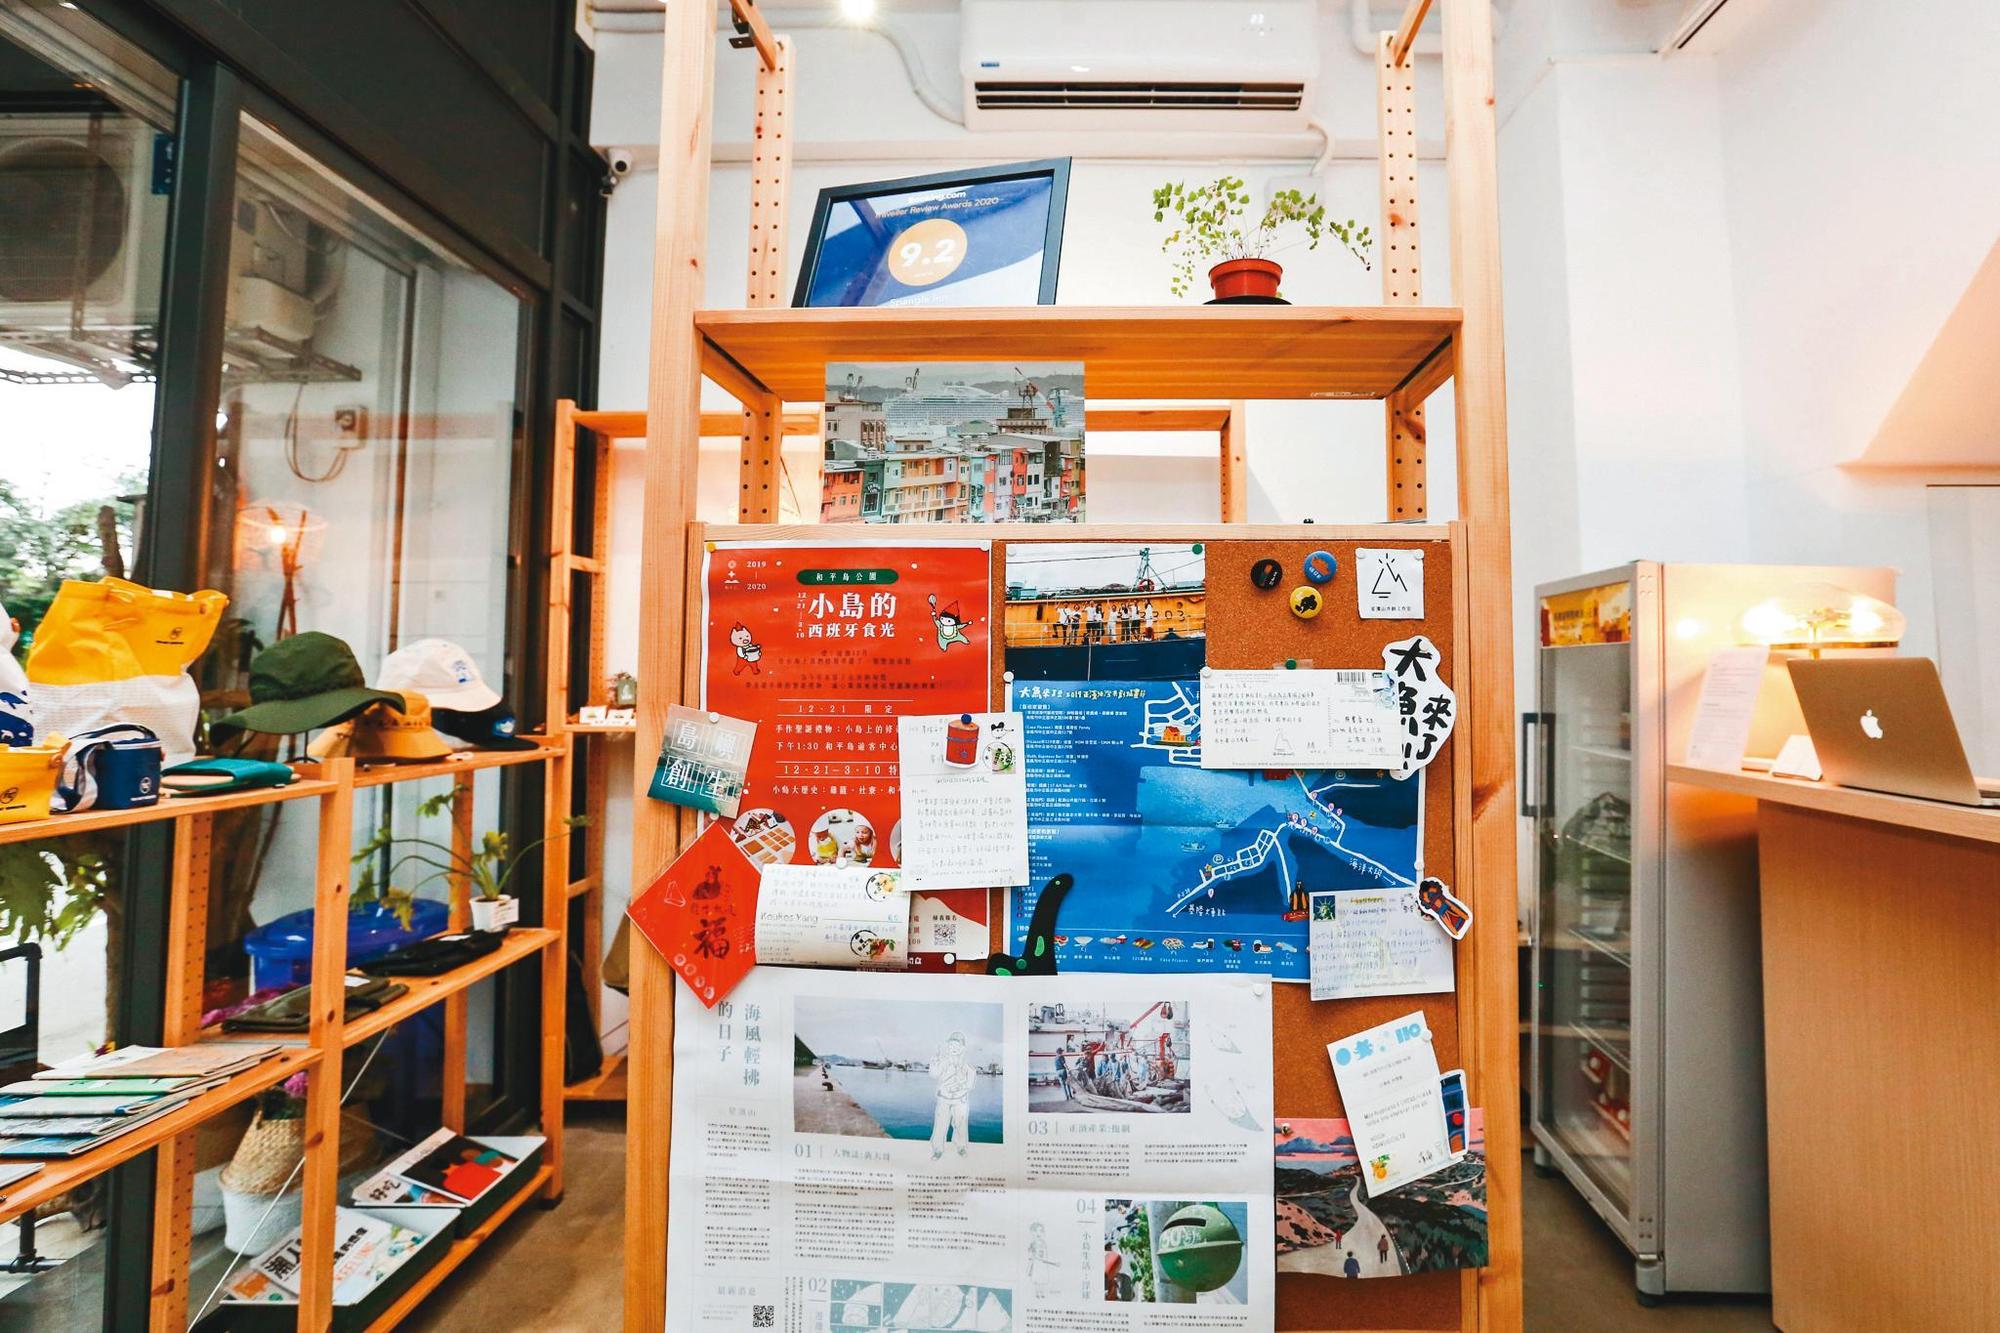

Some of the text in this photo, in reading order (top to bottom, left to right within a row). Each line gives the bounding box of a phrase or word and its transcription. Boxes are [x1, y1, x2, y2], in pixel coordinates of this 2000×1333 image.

[910, 203, 940, 214] Review
[941, 200, 973, 210] Awards
[974, 196, 1000, 207] 2020
[900, 238, 955, 267] 9.2
[746, 560, 767, 568] 2019
[815, 571, 878, 582] 和平島公園
[807, 592, 897, 620] 小島的
[807, 622, 895, 639] 西班牙食光
[718, 1000, 733, 1062] 的日子
[744, 1003, 762, 1087] 海風輕拂
[1028, 1121, 1049, 1135] 03
[794, 1143, 812, 1158] 01
[1076, 1199, 1097, 1214] 04
[808, 1278, 827, 1293] 02
